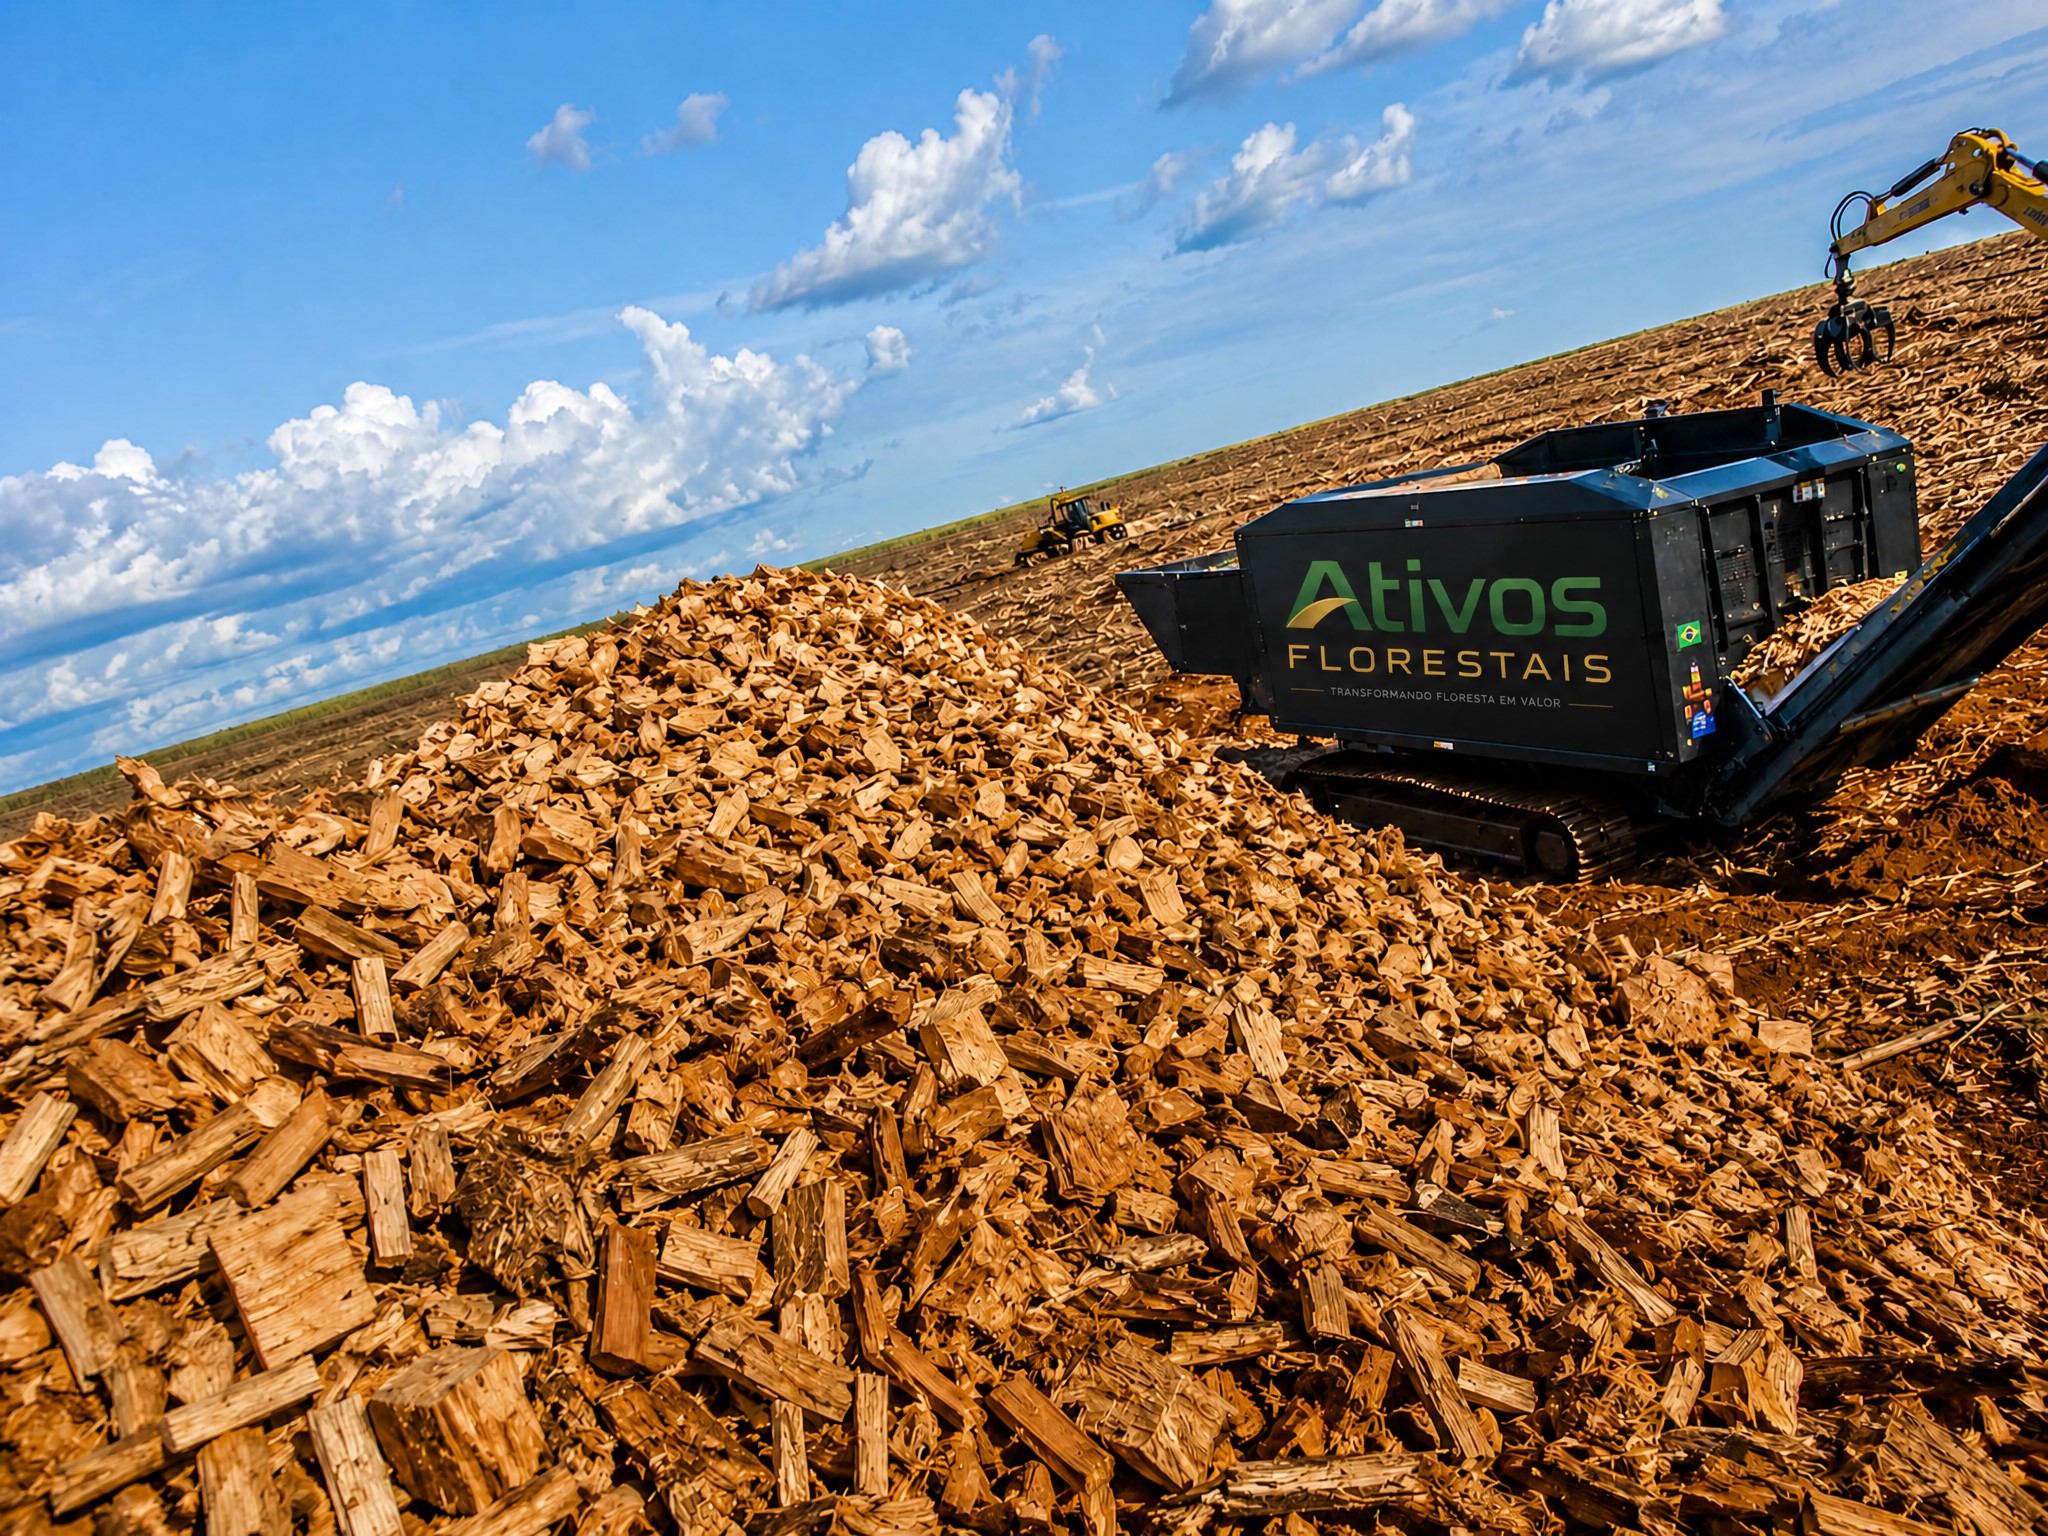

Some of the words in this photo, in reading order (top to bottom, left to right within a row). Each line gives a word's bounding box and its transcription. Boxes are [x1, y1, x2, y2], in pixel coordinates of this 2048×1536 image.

[1285, 559, 1607, 638] Ativos
[1288, 644, 1612, 684] FLORESTAIS
[1330, 687, 1432, 701] TRANSFORMANDO
[1436, 692, 1495, 704] FLORESTA
[1499, 695, 1516, 706] EM
[1520, 696, 1561, 708] VALOR
